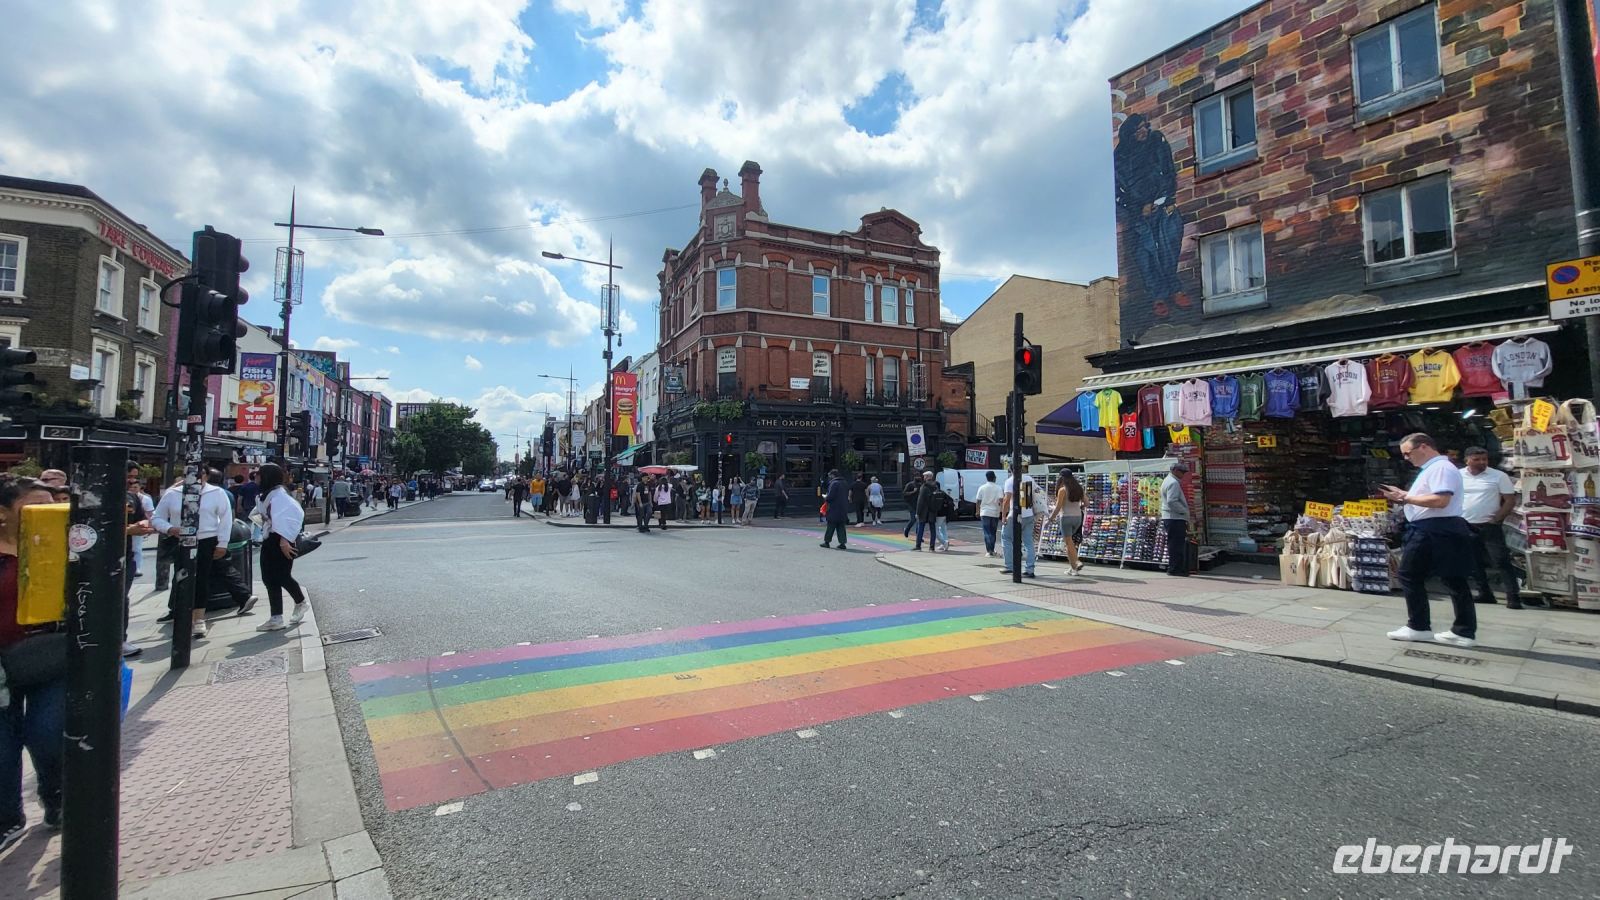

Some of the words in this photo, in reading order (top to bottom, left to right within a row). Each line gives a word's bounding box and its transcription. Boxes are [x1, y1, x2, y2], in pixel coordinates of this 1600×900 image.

[99, 223, 127, 250] TAKE
[131, 240, 176, 279] COURAGE
[1504, 352, 1536, 362] LONDON
[1414, 363, 1443, 372] LONDON
[1333, 372, 1358, 382] LONDON
[1125, 427, 1136, 437] 23
[1259, 437, 1273, 446] £1
[1308, 502, 1316, 510] £2
